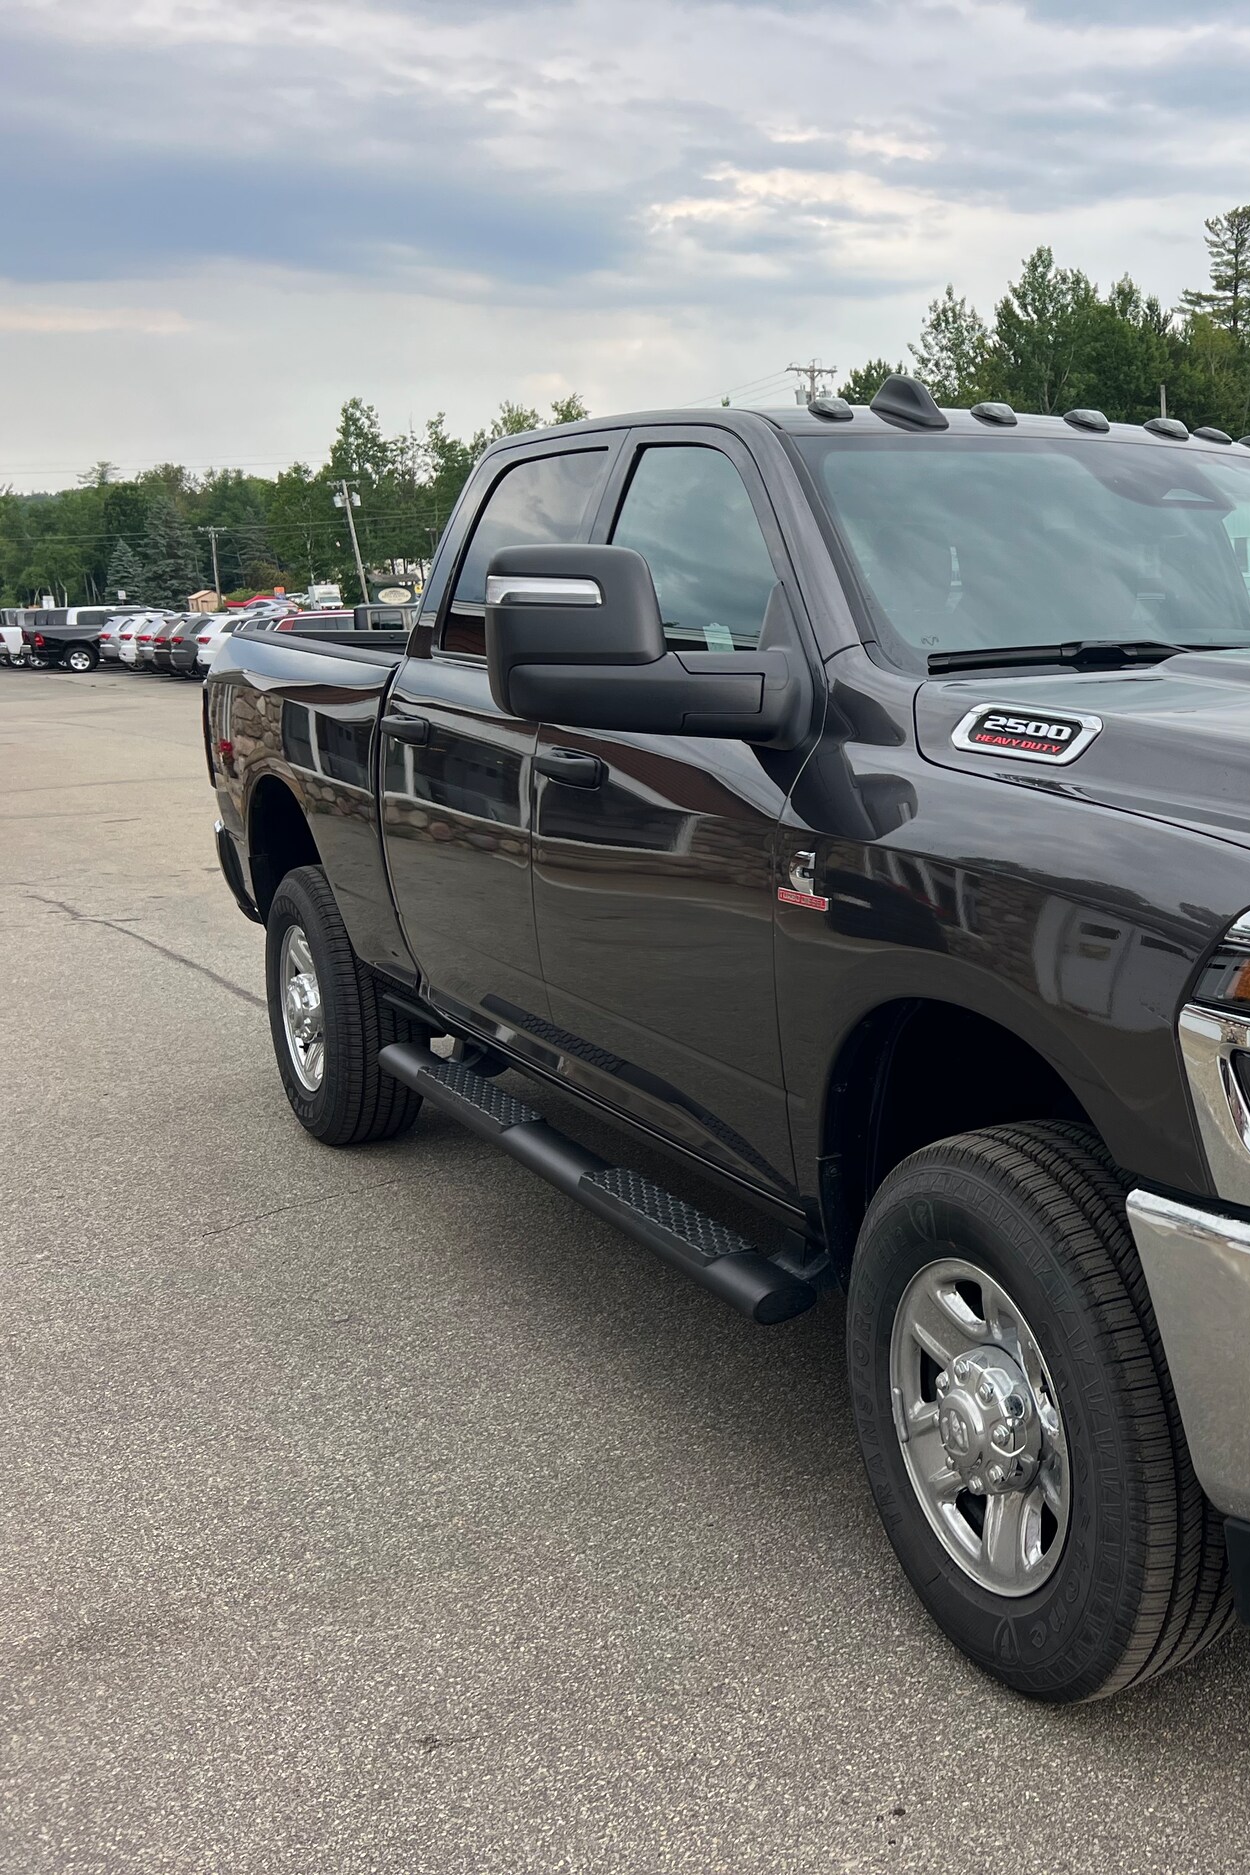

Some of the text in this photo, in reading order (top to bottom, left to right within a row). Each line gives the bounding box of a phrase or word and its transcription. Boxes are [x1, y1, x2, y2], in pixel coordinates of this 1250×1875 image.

[983, 715, 1072, 741] 2500
[975, 734, 1062, 753] HEAVY DUTY
